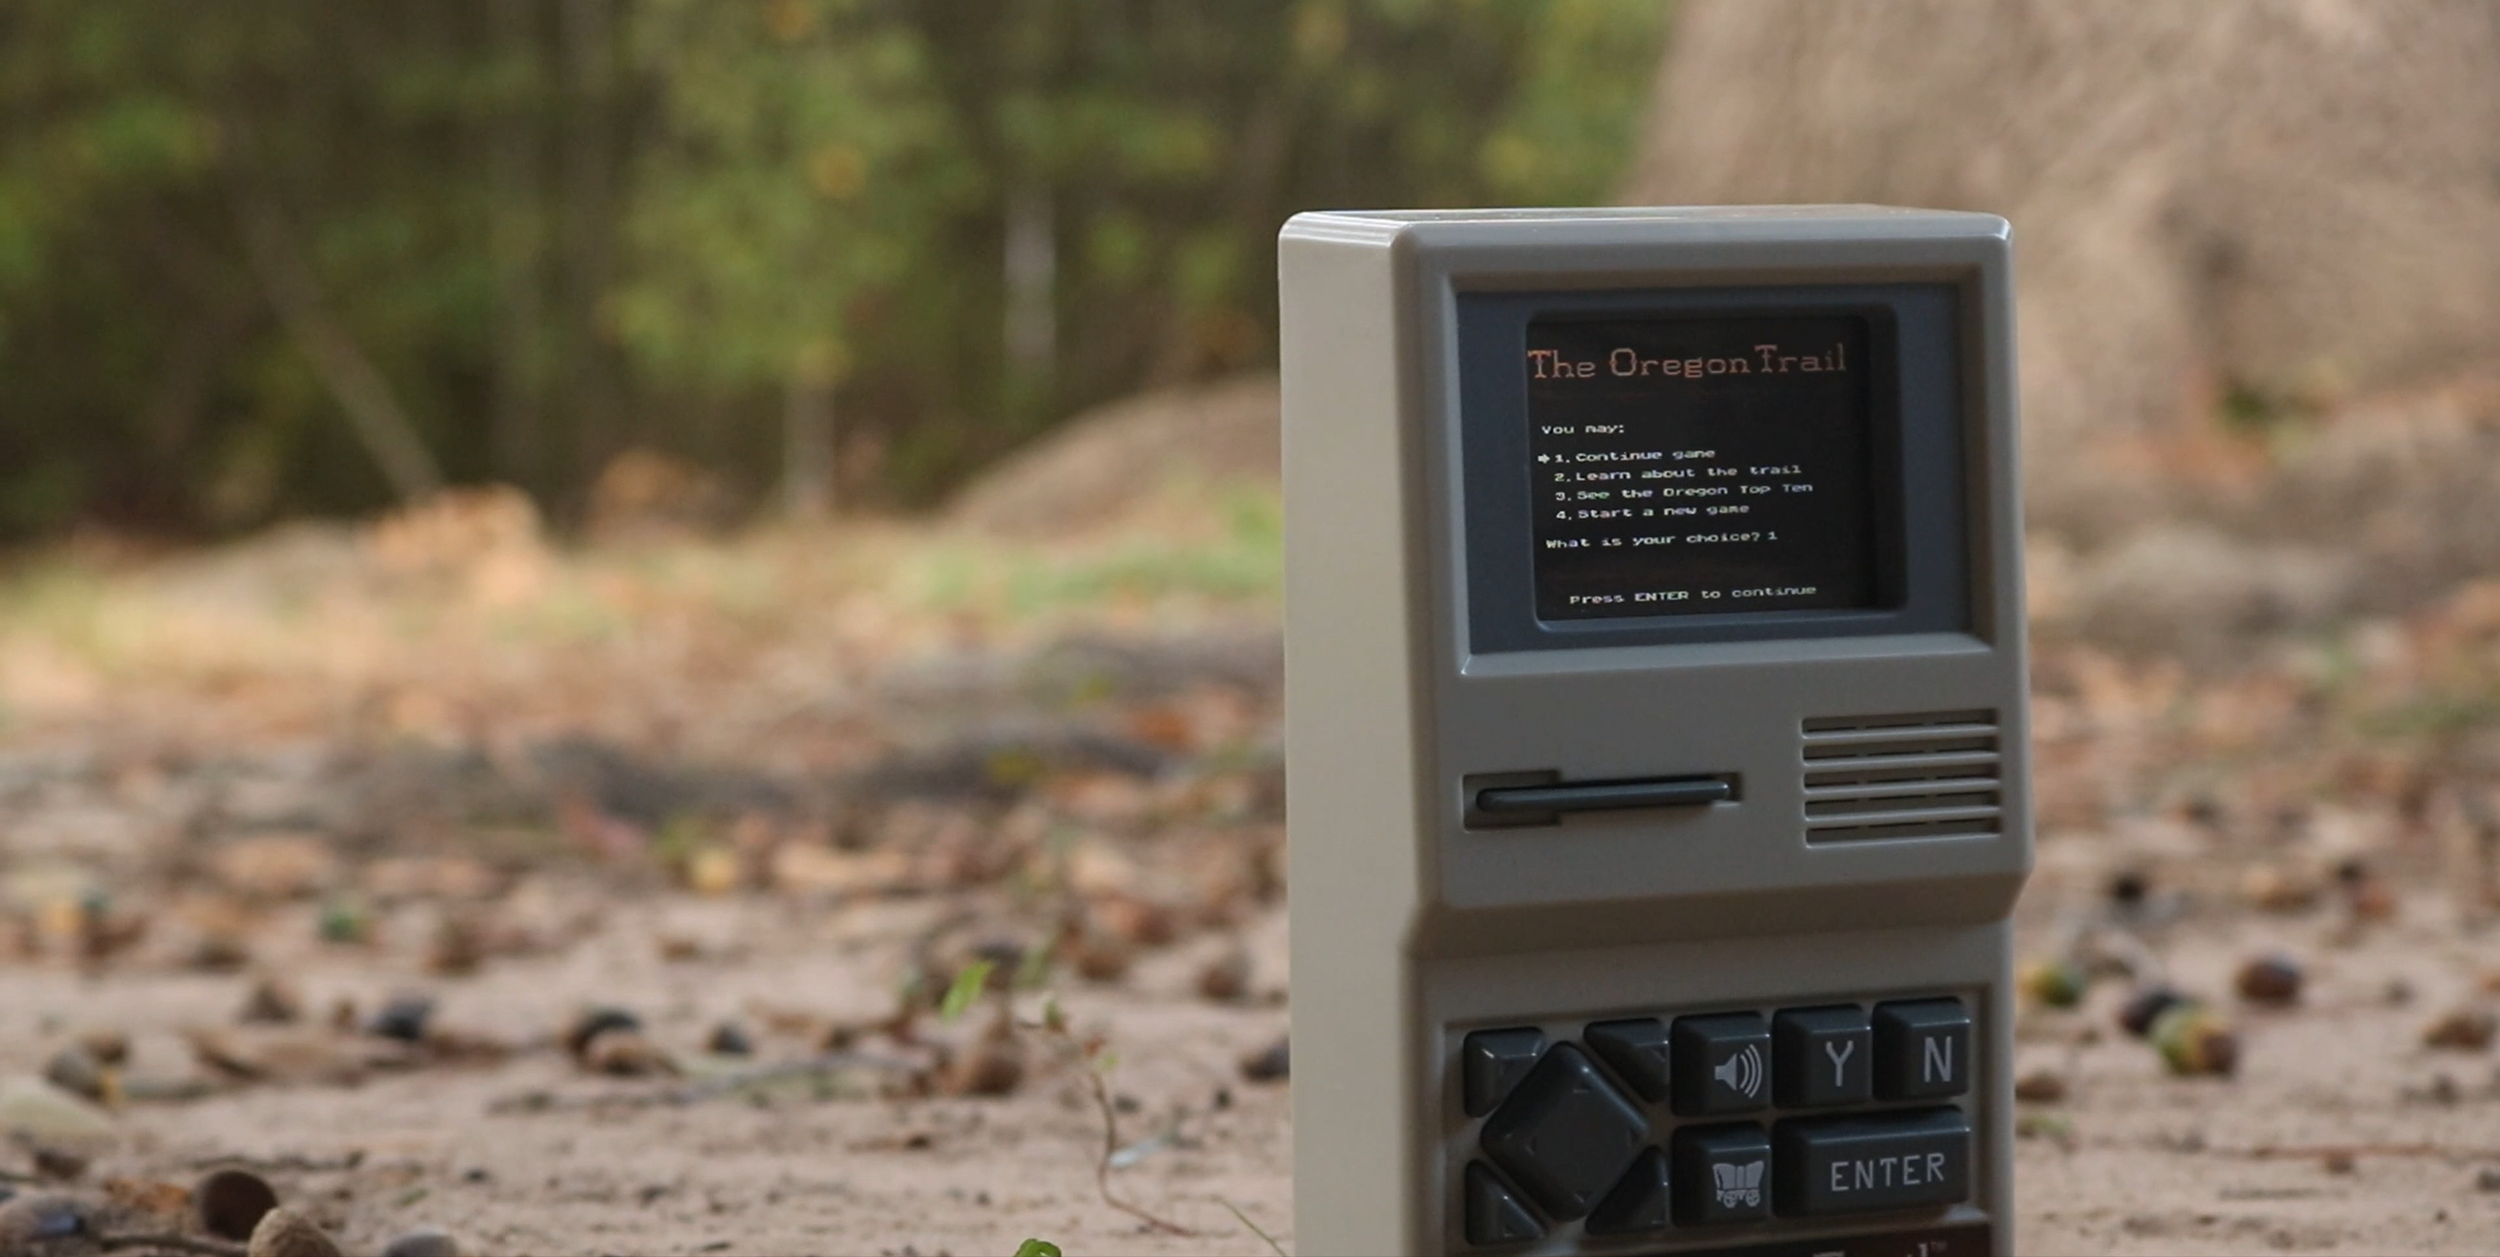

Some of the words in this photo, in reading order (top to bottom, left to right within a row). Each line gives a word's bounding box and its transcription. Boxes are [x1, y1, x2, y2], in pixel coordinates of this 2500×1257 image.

[1526, 349, 1596, 379] The
[1608, 347, 1751, 379] Oregon
[1753, 342, 1846, 374] Trail
[1541, 425, 1575, 435] You
[1584, 424, 1625, 434] may:
[1671, 449, 1716, 461] game
[1641, 468, 1696, 479] about
[1707, 467, 1738, 477] the
[1749, 464, 1802, 475] trail
[1621, 489, 1654, 499] the
[1662, 486, 1729, 497] Oregon
[1739, 485, 1771, 495] Top
[1782, 483, 1814, 493] Ten
[1642, 508, 1654, 517] a
[1663, 507, 1697, 516] new
[1705, 504, 1750, 516] game
[1545, 538, 1591, 549] What
[1601, 537, 1622, 547] is
[1632, 535, 1676, 547] your
[1685, 531, 1761, 544] choice?
[1768, 531, 1778, 541] 1
[1569, 594, 1625, 605] Press
[1634, 590, 1689, 602] ENTER
[1701, 590, 1721, 599] to
[1731, 586, 1817, 598] continue
[1825, 1039, 1854, 1087] Y
[1923, 1035, 1953, 1083] N
[1830, 1152, 1946, 1192] ENTER
